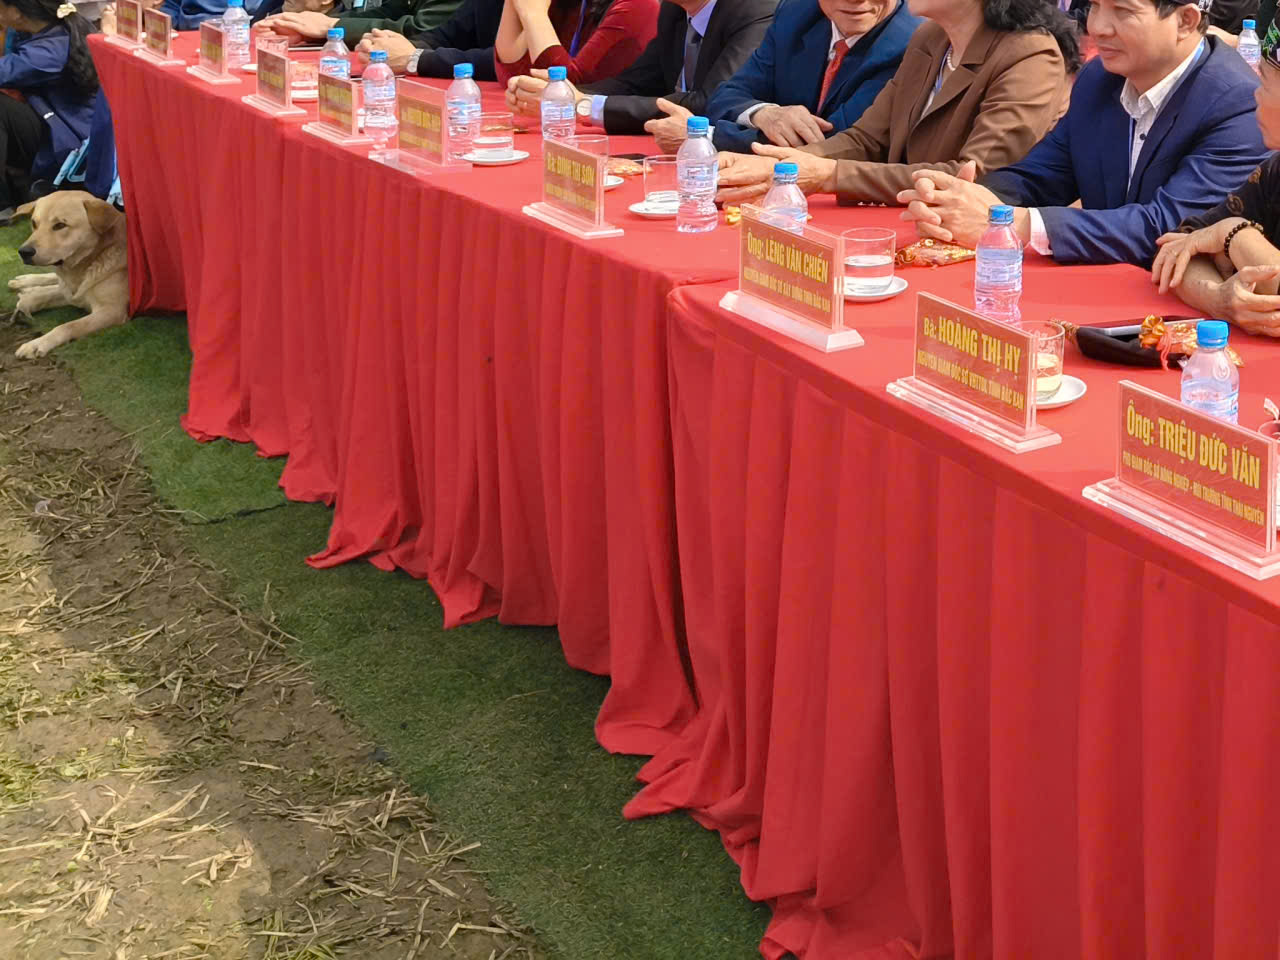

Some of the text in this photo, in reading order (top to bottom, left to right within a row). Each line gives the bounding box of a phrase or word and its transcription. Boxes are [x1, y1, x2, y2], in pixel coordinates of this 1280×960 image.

[747, 227, 764, 261] Ông:
[803, 251, 829, 284] CHIẾN
[923, 316, 937, 339] Bà:
[938, 315, 978, 357] HOÀNG
[982, 333, 1001, 373] THỊ
[1127, 399, 1261, 489] Ông: TRIỆU ĐỨC VĂN
